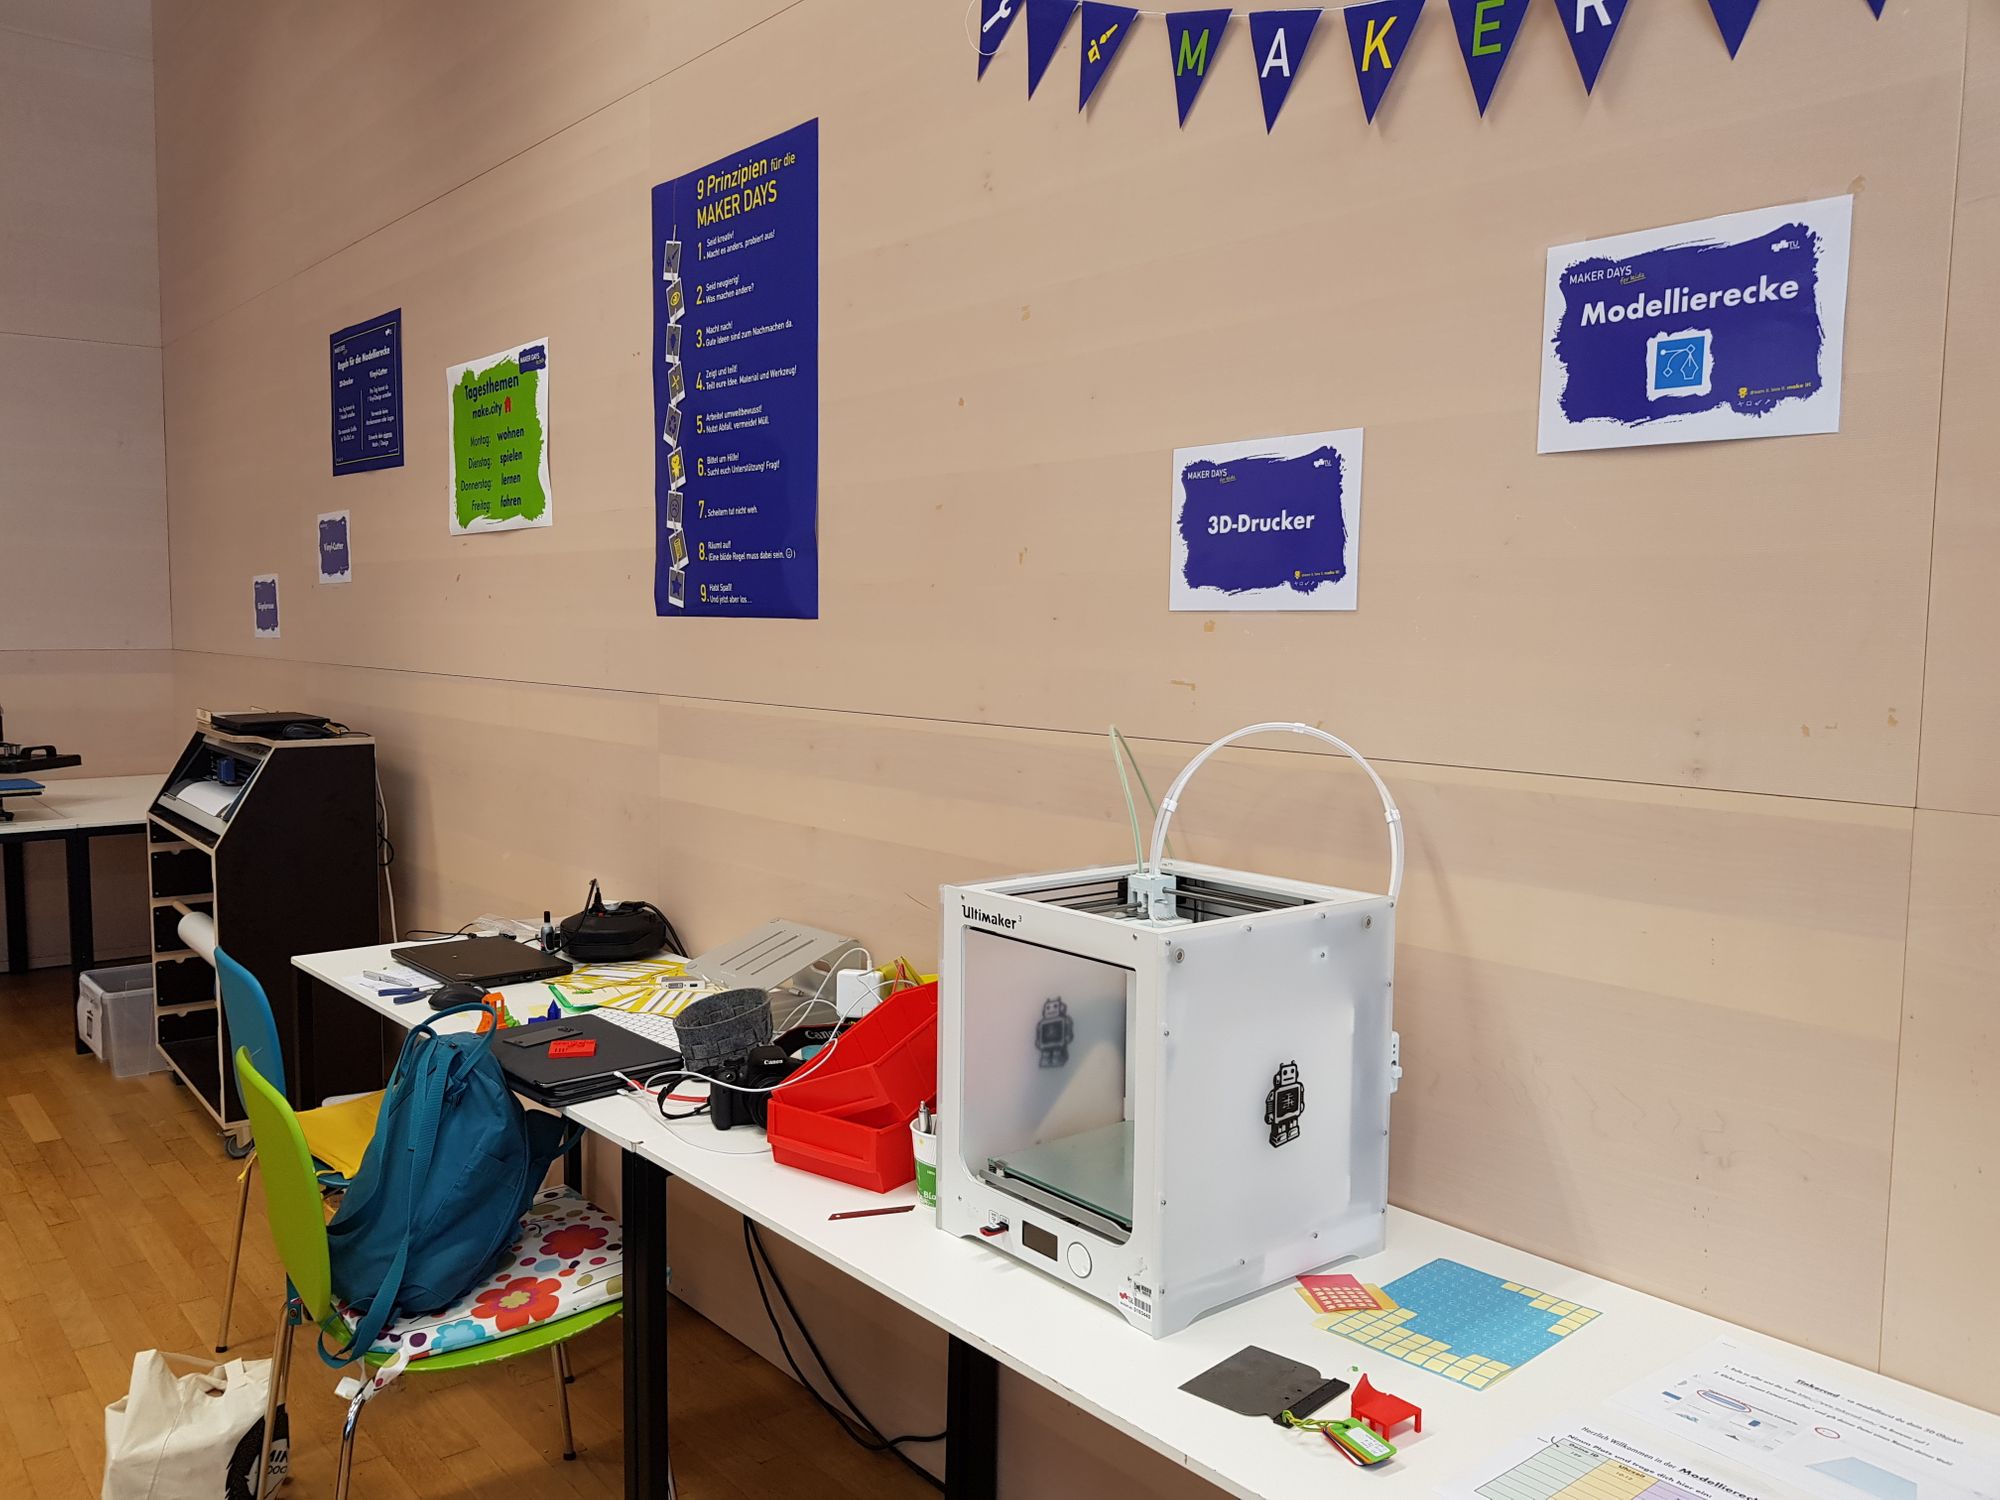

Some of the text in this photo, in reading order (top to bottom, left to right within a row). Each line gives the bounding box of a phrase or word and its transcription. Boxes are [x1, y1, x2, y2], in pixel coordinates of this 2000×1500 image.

[697, 152, 796, 200] 9 Prinzipien für die
[697, 180, 778, 229] MAKER DAYS
[698, 242, 706, 261] 1.
[1569, 265, 1632, 285] MAKER DAYS
[696, 285, 705, 305] 2.
[706, 281, 716, 292] Seid
[706, 282, 755, 304] Was machen andere?
[1580, 274, 1800, 328] Modellierecke
[696, 329, 705, 348] 3.
[706, 338, 716, 347] Gute
[752, 321, 785, 336] Nachmachen
[718, 366, 727, 376] und
[760, 371, 770, 380] und
[464, 375, 519, 403] Tagesthemen
[696, 372, 705, 390] 4.
[496, 426, 525, 441] wohnen
[696, 415, 705, 434] 5.
[500, 448, 523, 466] spielen
[697, 457, 707, 477] 6.
[1187, 470, 1210, 480] MAKER
[1211, 468, 1227, 478] DAYS
[501, 473, 521, 485] lernen
[500, 494, 522, 508] fahren
[698, 500, 707, 519] 7.
[1207, 509, 1315, 535] 3D-Drucker
[698, 542, 708, 561] 8.
[700, 584, 709, 603] 9.
[961, 904, 1017, 930] Ultimaker
[1581, 1426, 1609, 1441] Herzlich
[1610, 1438, 1653, 1460] Willkommen
[1663, 1461, 1677, 1470] der
[1567, 1434, 1592, 1447] Nimm
[1614, 1454, 1631, 1464] und
[1632, 1462, 1655, 1474] trage
[1656, 1472, 1674, 1482] dich
[1676, 1480, 1695, 1491] hier
